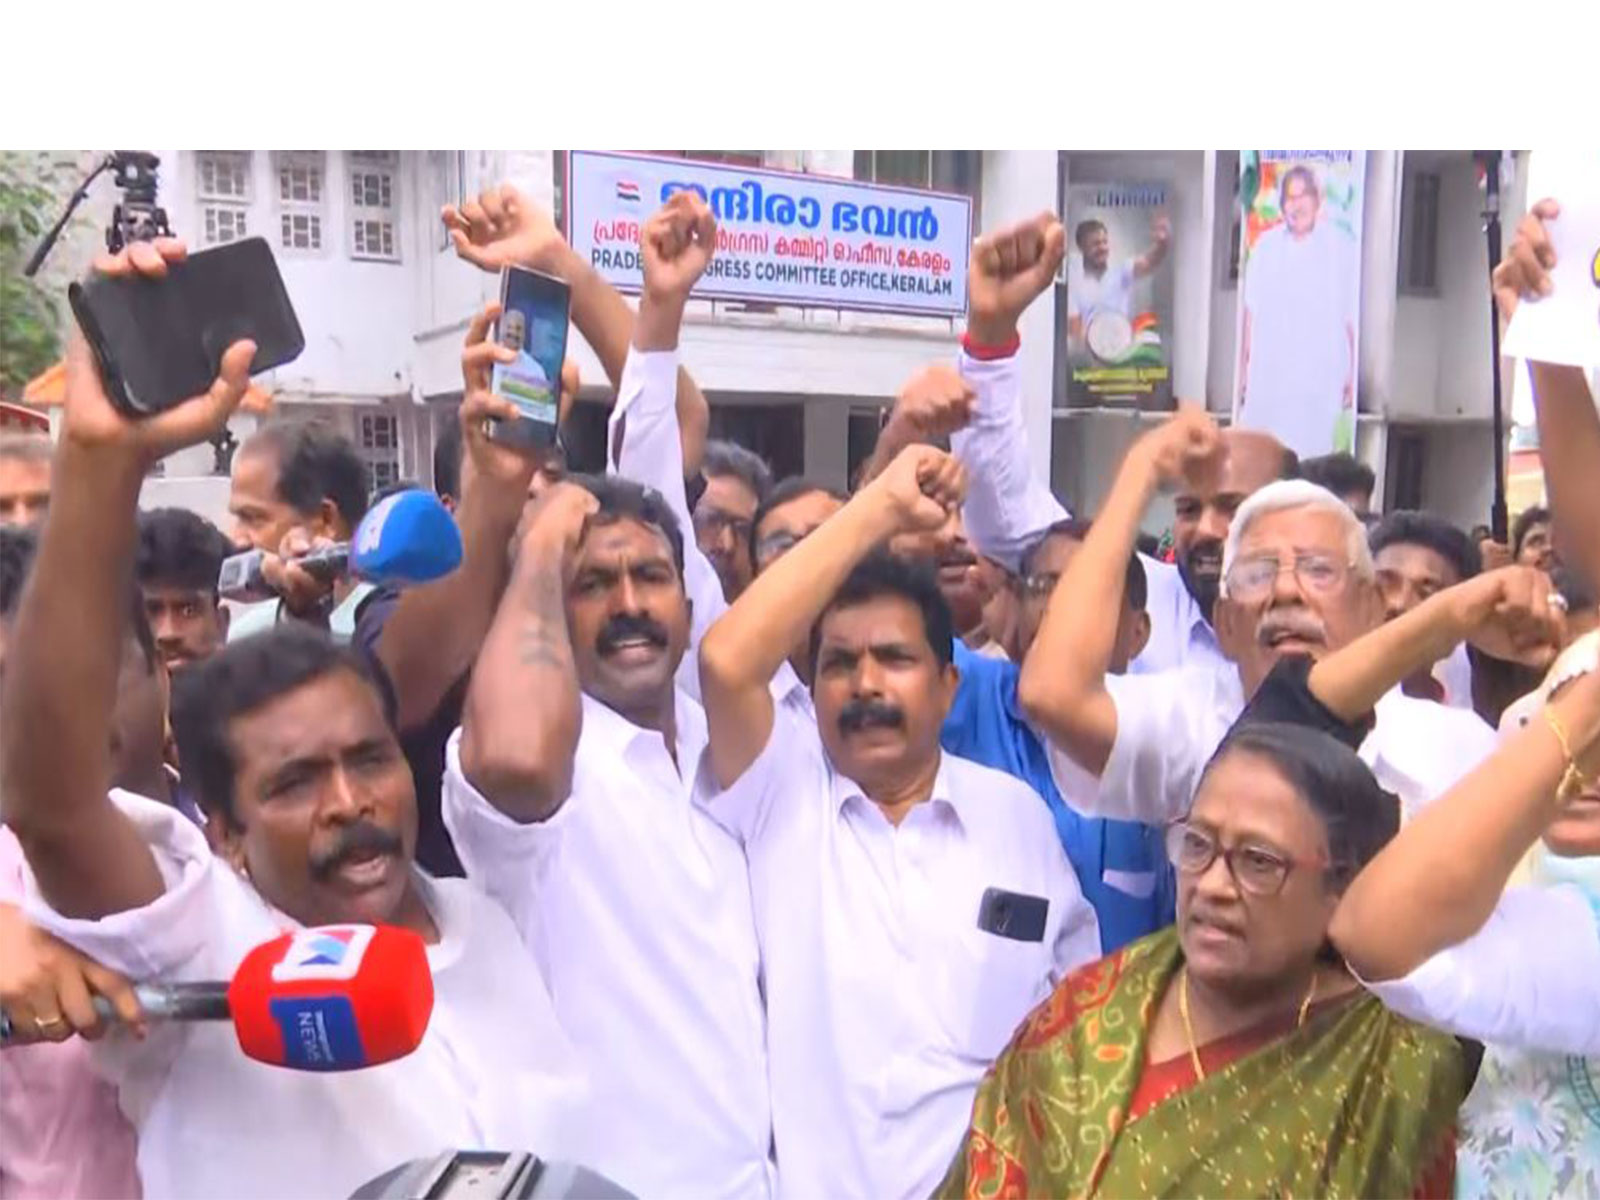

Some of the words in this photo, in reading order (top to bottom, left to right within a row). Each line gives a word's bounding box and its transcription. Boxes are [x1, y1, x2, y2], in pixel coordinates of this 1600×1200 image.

[832, 201, 939, 241] ഭവൻ
[591, 249, 642, 270] PRADE
[705, 258, 751, 279] GRESS
[755, 262, 836, 287] COMMITTEE
